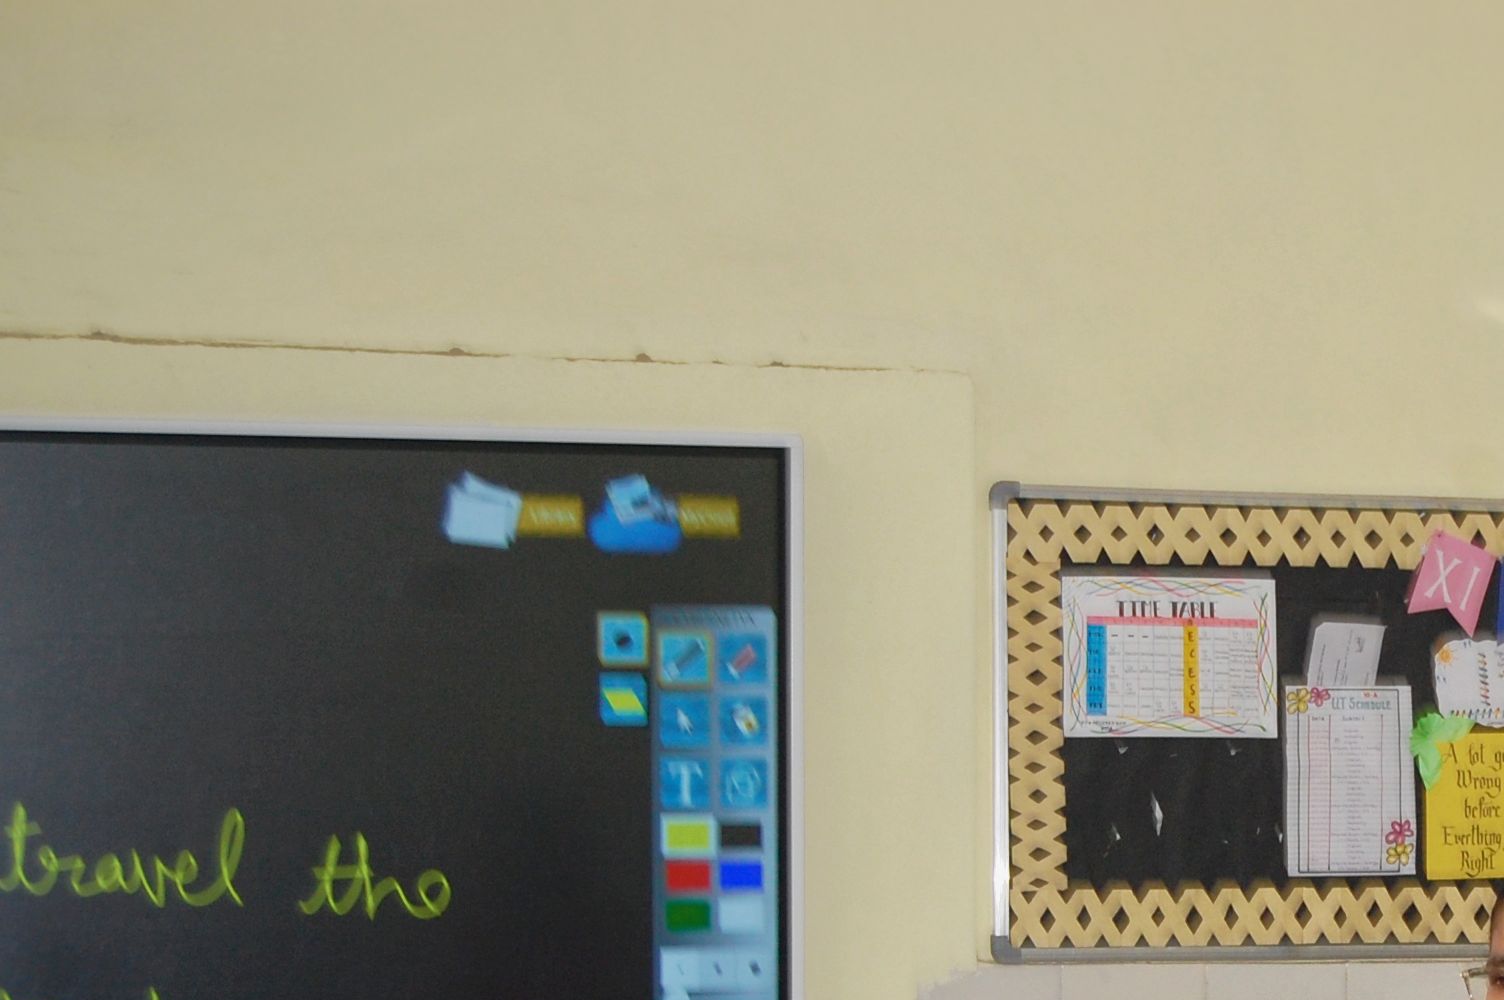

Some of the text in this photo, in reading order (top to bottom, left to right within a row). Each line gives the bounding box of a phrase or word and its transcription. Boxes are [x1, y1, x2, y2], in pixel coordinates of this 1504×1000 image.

[1423, 549, 1481, 612] XI
[1116, 600, 1218, 619] TIME TABLE
[1445, 743, 1458, 764] A
[1468, 743, 1485, 765] lot
[1456, 769, 1502, 798] Wrong
[1464, 797, 1501, 820] before
[0, 801, 452, 922] travel the
[1460, 850, 1495, 878] Right
